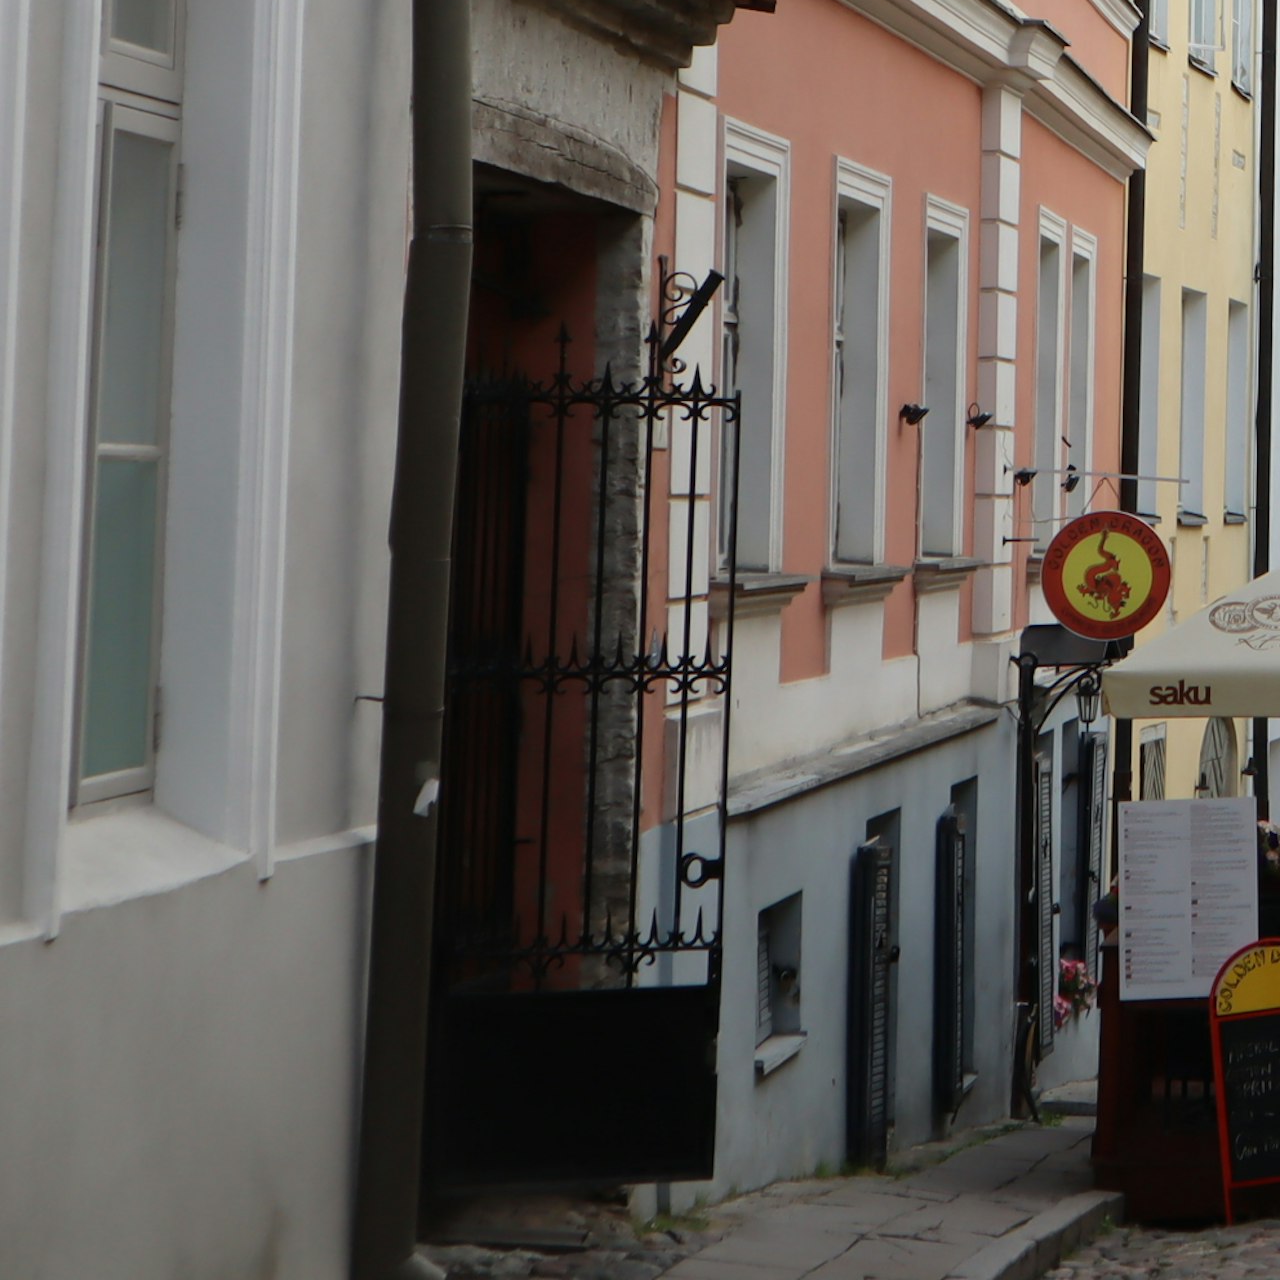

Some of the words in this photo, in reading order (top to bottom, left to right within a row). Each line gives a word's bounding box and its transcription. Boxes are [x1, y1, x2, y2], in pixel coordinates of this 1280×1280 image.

[1048, 517, 1100, 570] GOLDEN
[1149, 679, 1212, 706] saku
[1218, 949, 1266, 1012] GOLDEN
